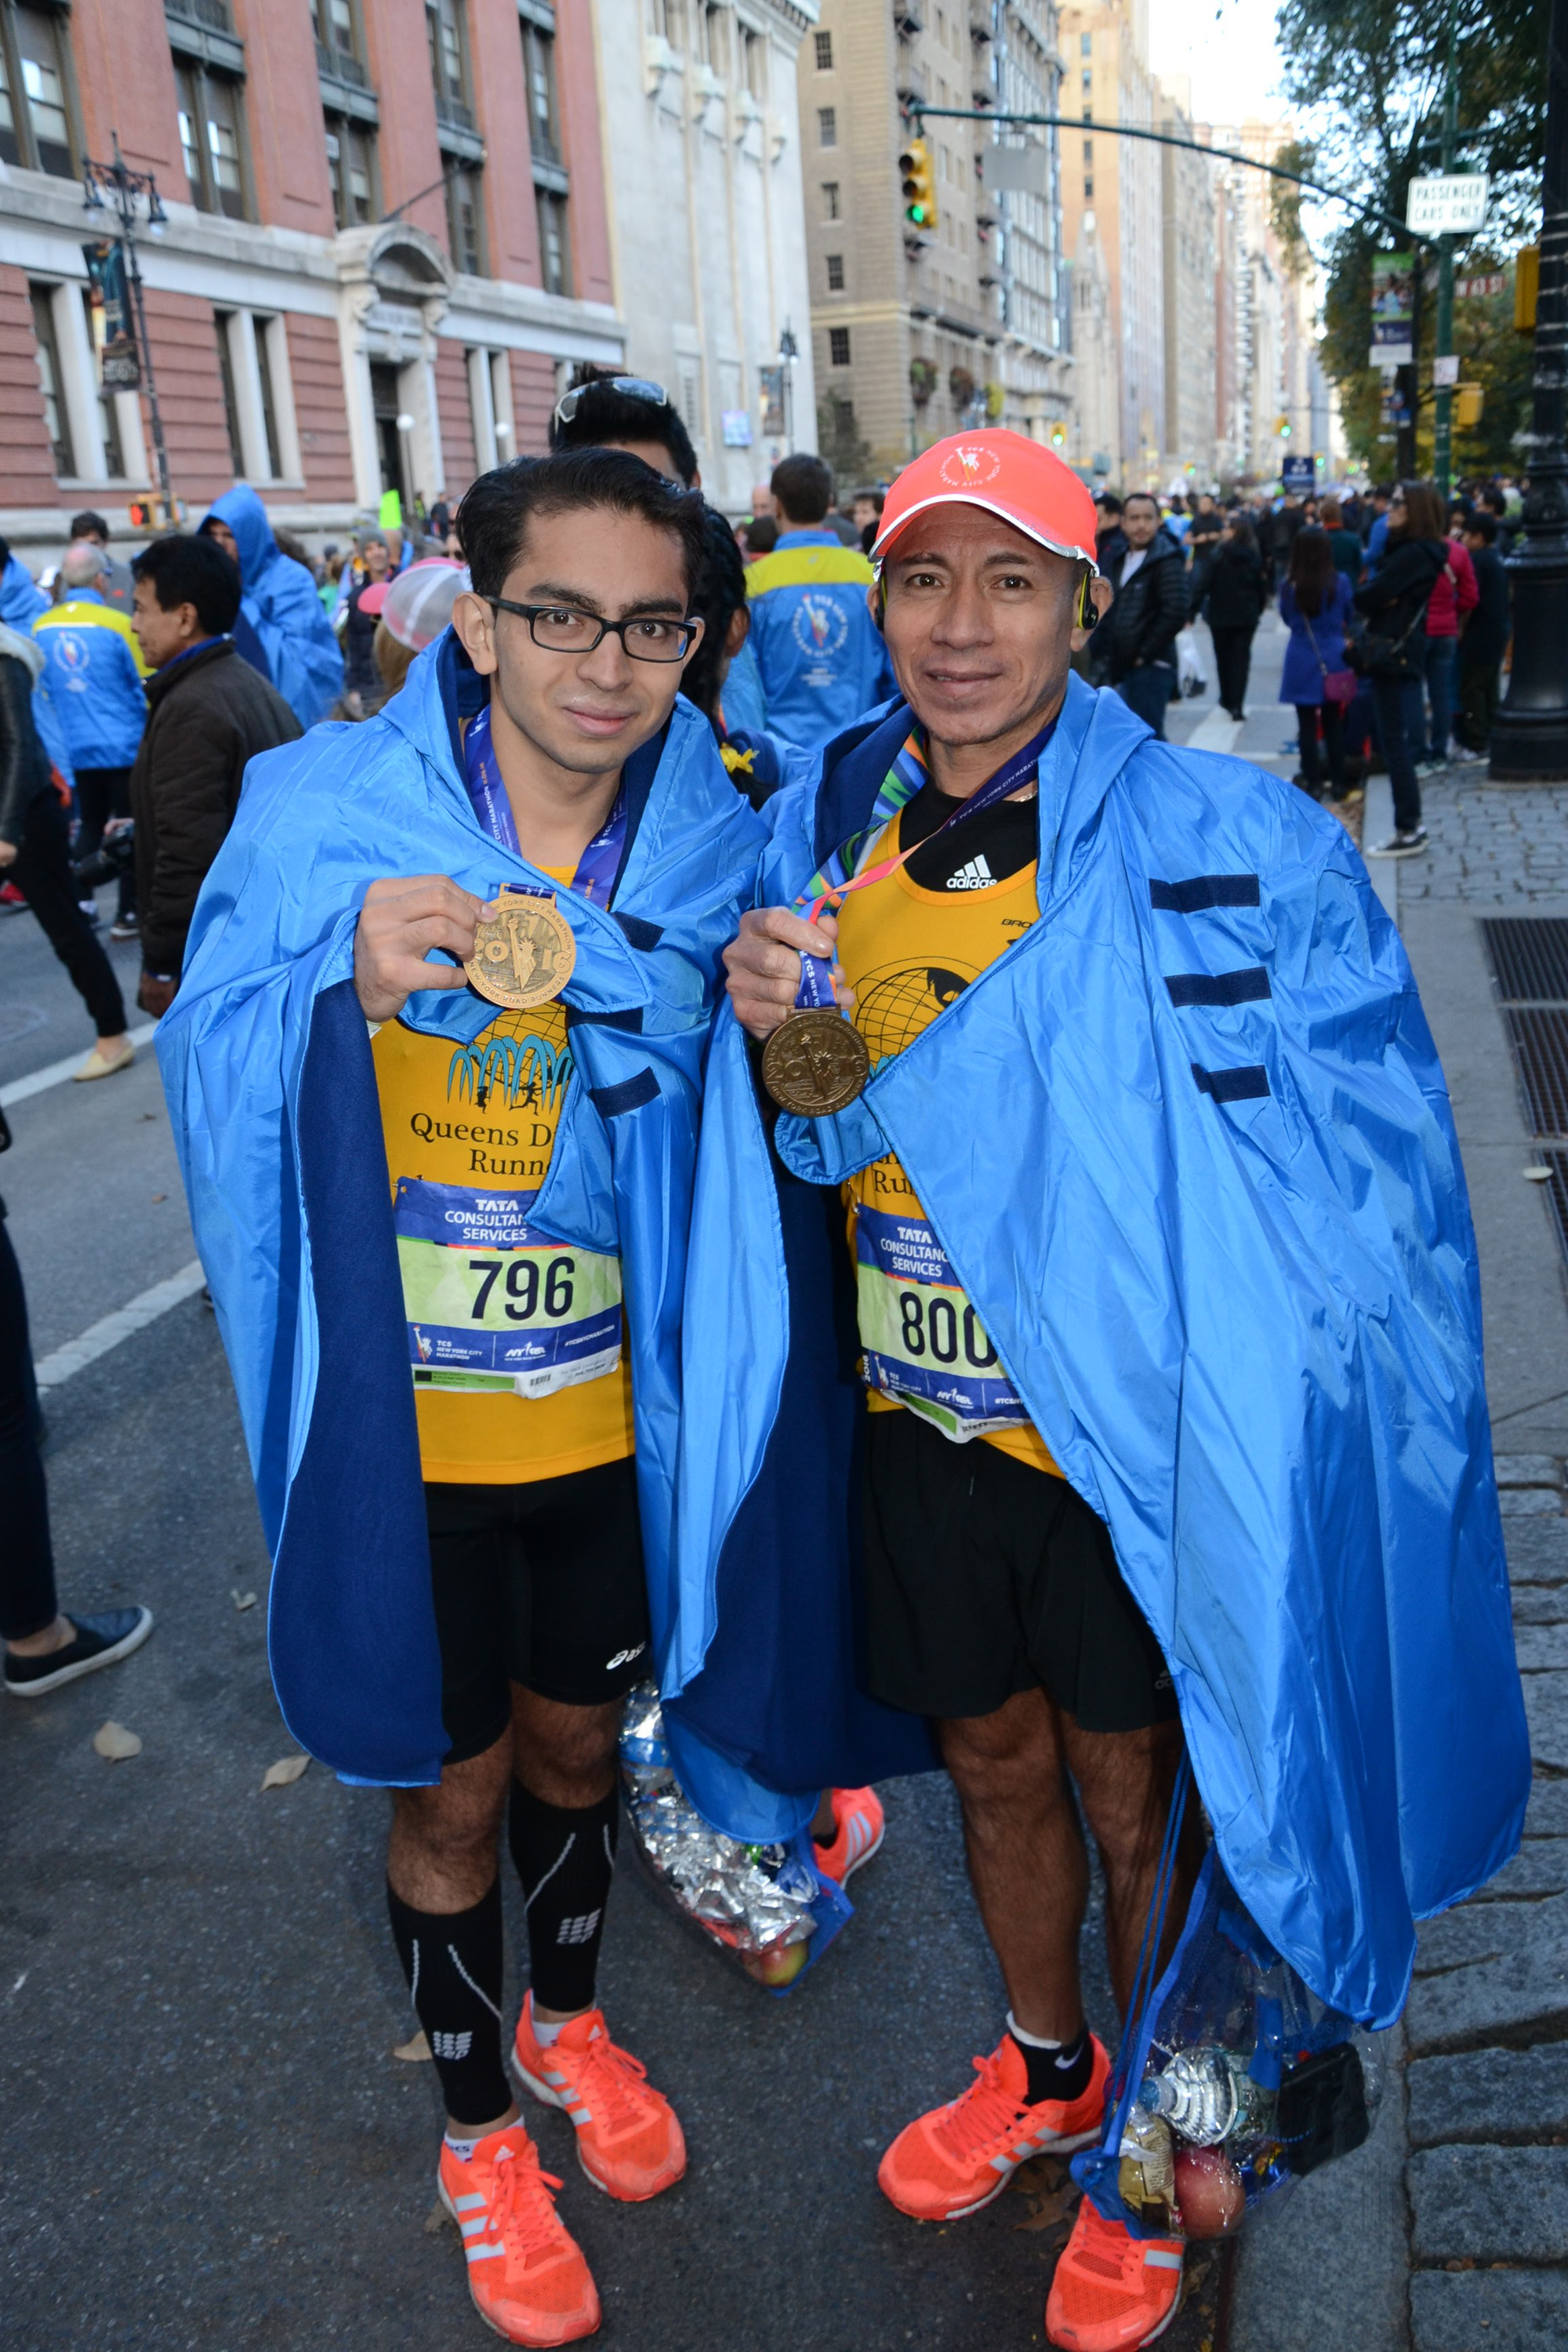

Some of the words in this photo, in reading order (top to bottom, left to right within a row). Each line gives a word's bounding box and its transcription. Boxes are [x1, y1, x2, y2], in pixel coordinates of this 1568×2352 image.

[1417, 184, 1481, 199] PASSENGER
[1416, 207, 1443, 220] CARS
[1452, 205, 1480, 219] ONLY
[987, 786, 1003, 798] YORK
[1002, 775, 1015, 788] CITY
[484, 786, 498, 823] MARATHON
[492, 824, 502, 840] CITY
[946, 876, 997, 889] adidas
[503, 899, 524, 908] YORK
[528, 899, 545, 911] CITY
[470, 960, 481, 981] NEW
[480, 980, 501, 1000] YORK
[503, 995, 528, 1004] ROAD
[530, 976, 565, 1003] RUNNERS
[805, 959, 815, 978] TCS
[810, 979, 818, 996] NEW
[410, 1112, 519, 1146] Queens
[468, 1149, 551, 1176] Runn
[475, 1200, 519, 1210] TATA
[463, 1228, 528, 1241] SERVICES
[897, 1227, 933, 1244] TATA
[892, 1257, 942, 1277] SERVICES
[469, 1256, 575, 1321] 796
[899, 1291, 999, 1368] 800
